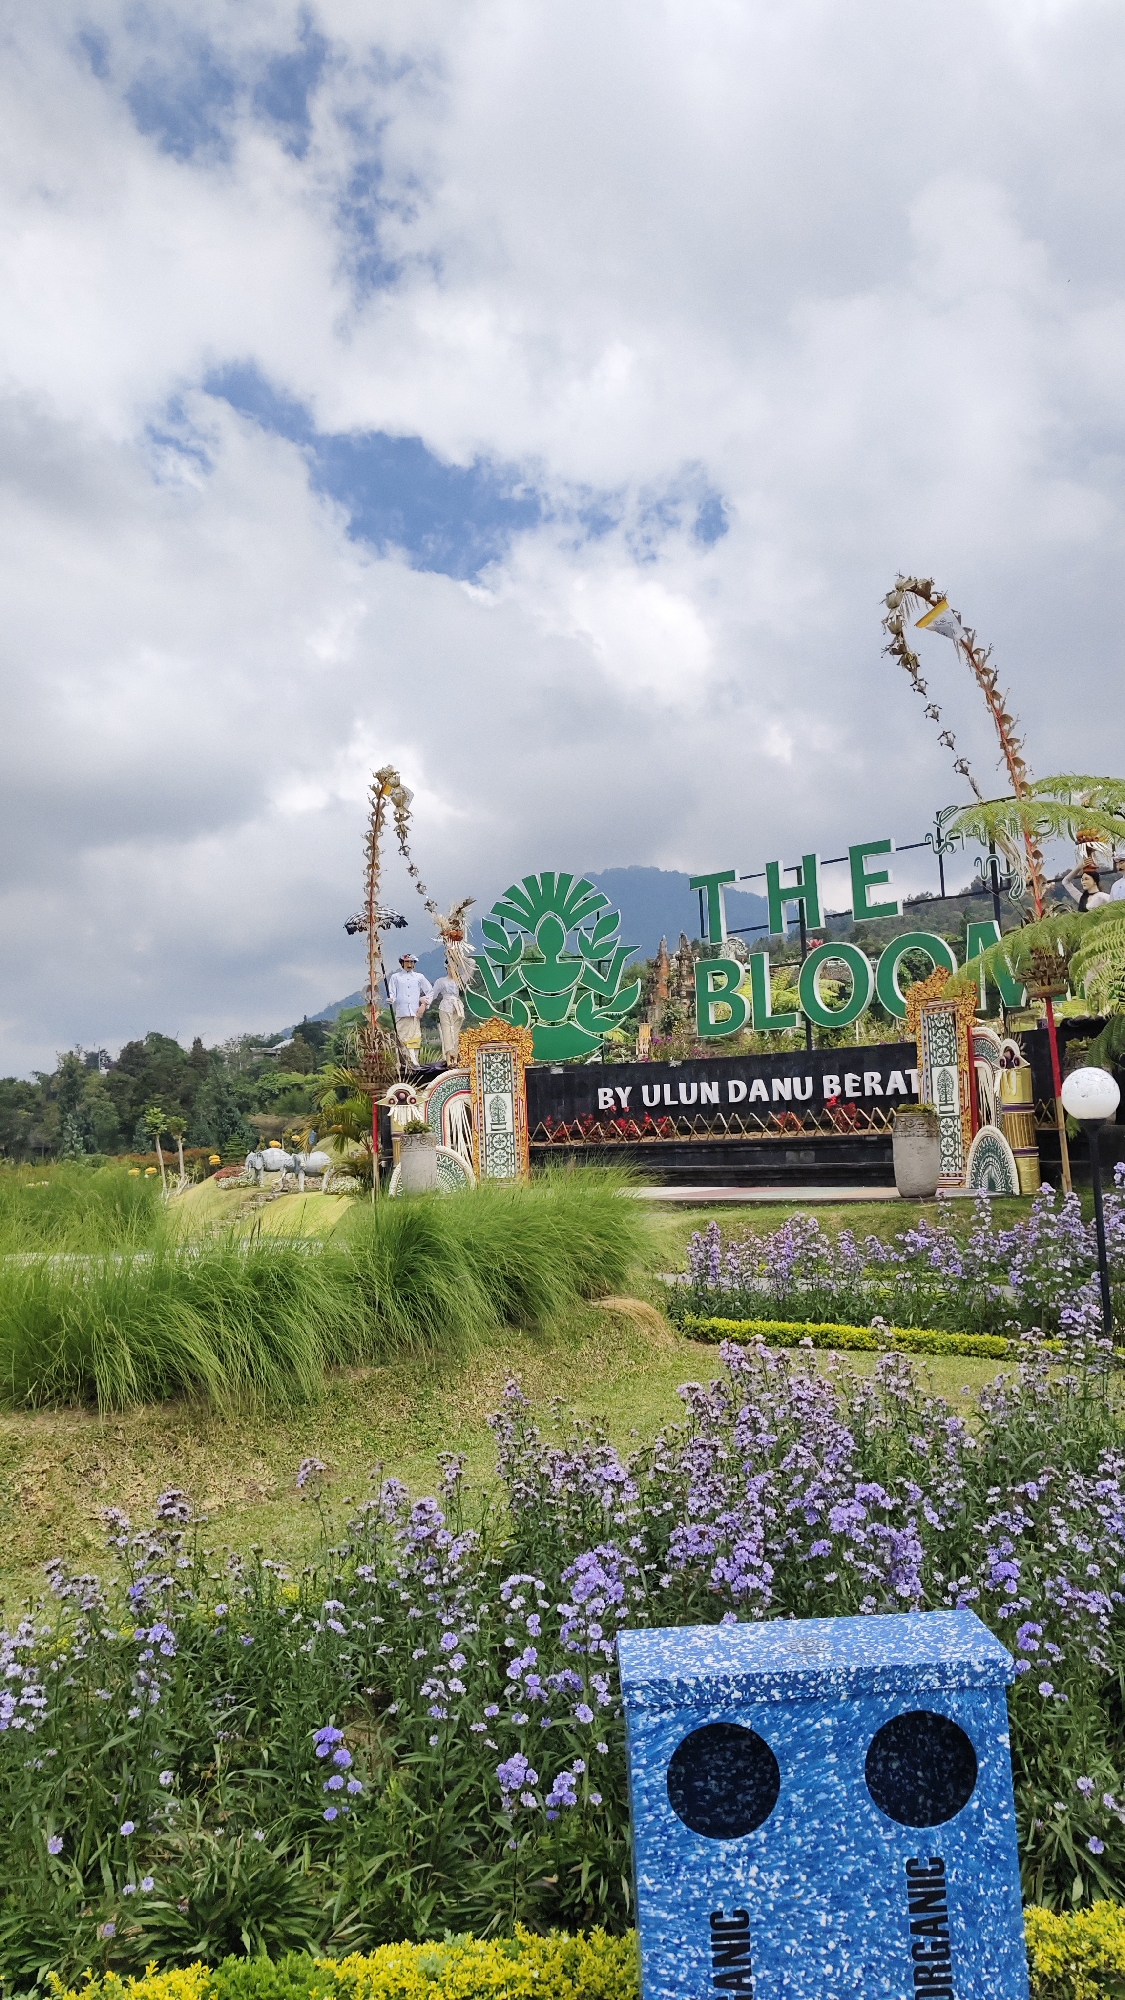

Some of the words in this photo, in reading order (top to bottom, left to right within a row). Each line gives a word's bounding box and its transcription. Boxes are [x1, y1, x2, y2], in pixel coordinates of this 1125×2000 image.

[690, 838, 904, 945] THE
[597, 1086, 632, 1110] BY
[641, 1081, 720, 1107] ULUN
[727, 1076, 813, 1103] DANU
[822, 1068, 919, 1099] BERAT
[709, 1909, 754, 2000] ANIC
